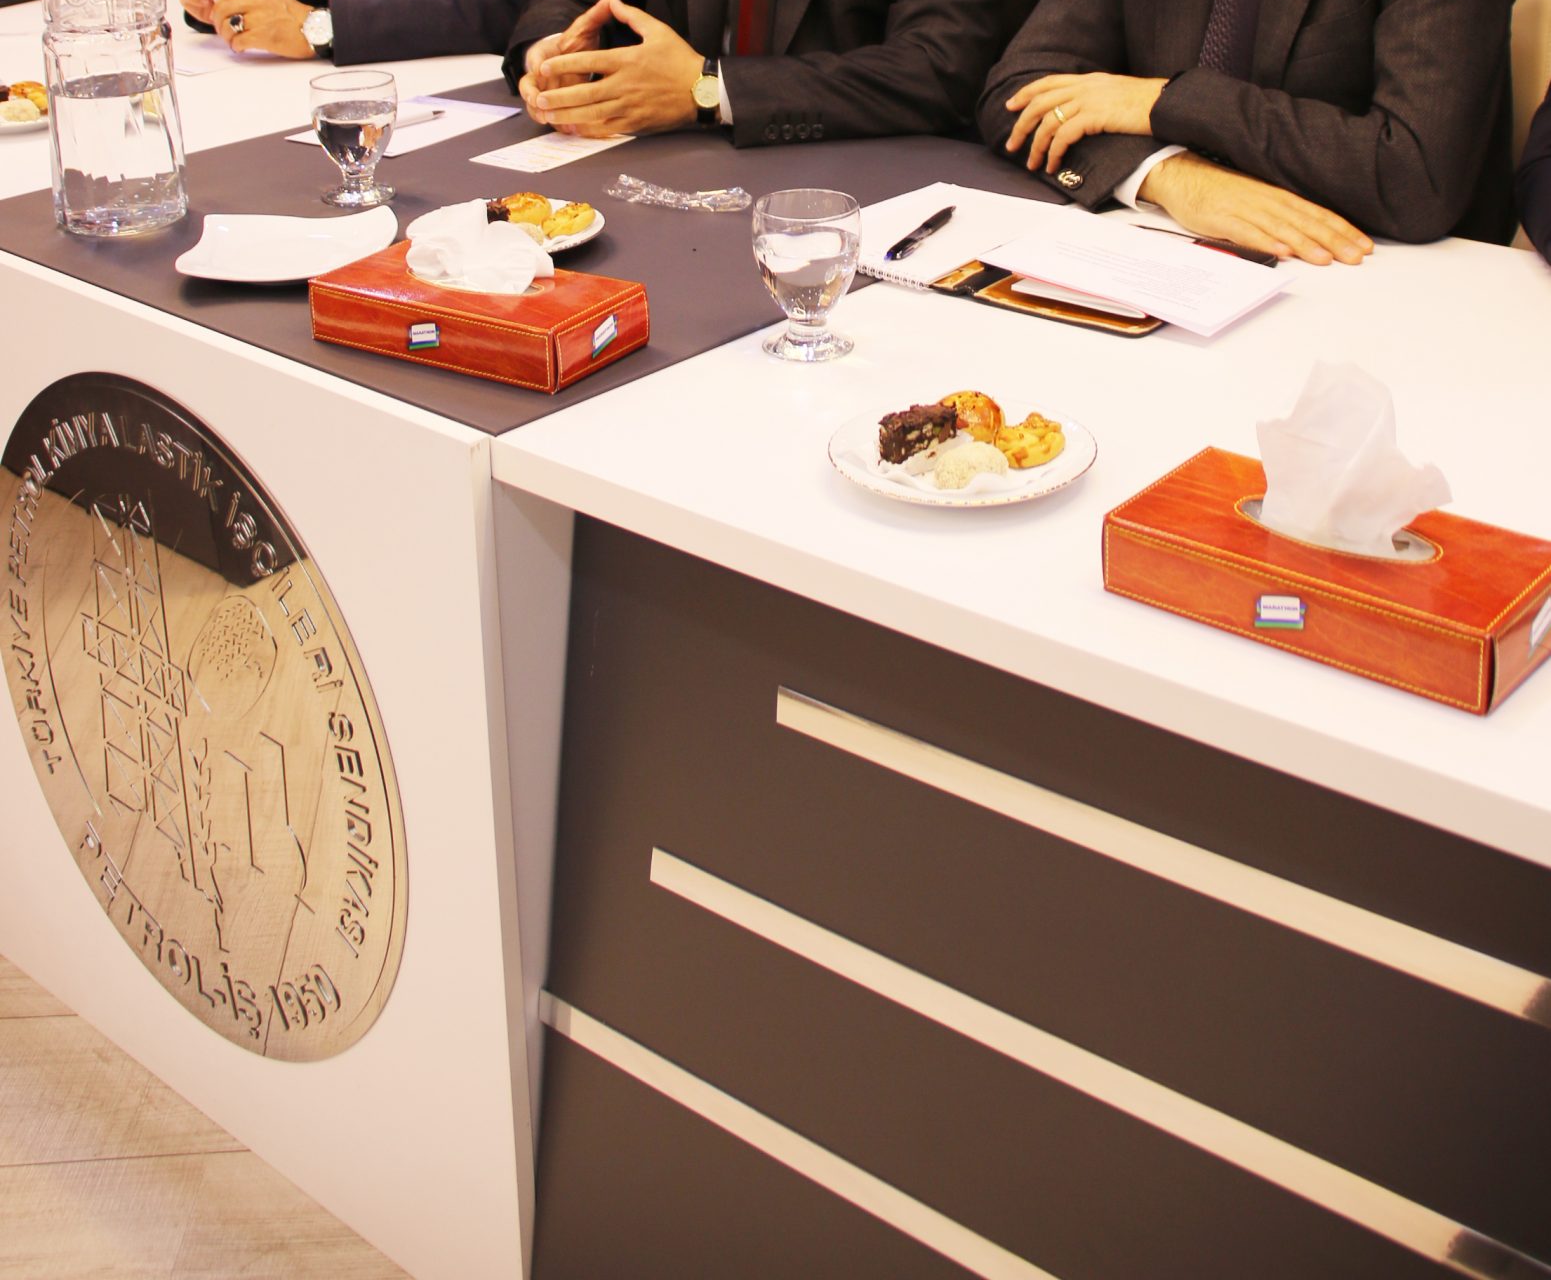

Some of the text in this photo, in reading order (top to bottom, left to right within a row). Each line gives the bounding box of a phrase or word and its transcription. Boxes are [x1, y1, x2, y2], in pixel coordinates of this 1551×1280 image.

[8, 453, 54, 589] PETROL
[42, 410, 120, 470] KİMYA
[120, 414, 225, 513] LASTİK
[327, 710, 379, 960] SENDİKASI
[267, 963, 342, 1032] 1950
